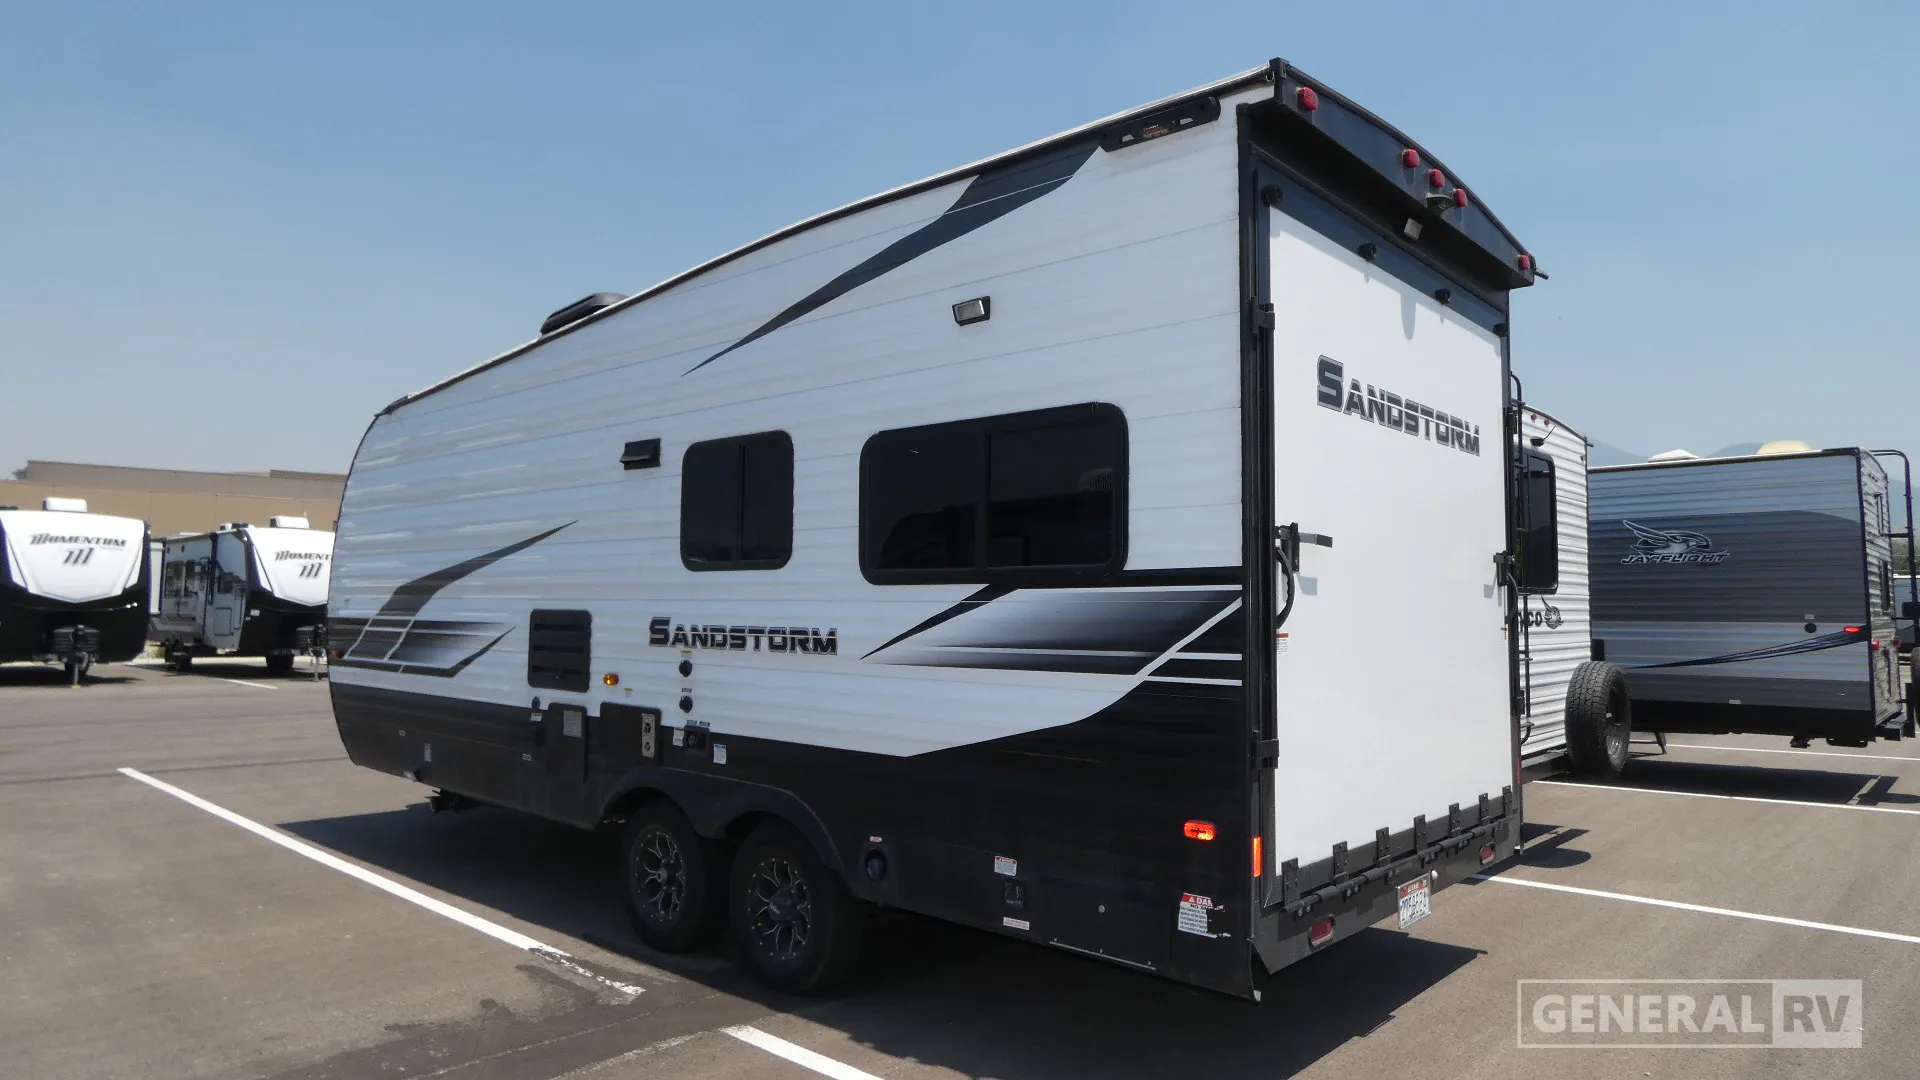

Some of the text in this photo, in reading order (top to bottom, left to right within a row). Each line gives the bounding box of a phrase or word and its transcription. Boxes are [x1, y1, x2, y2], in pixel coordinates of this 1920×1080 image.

[1316, 354, 1480, 456] SANDSTORM
[29, 533, 128, 547] MOMENTUM
[274, 550, 332, 561] MOMENT
[648, 616, 839, 655] SANDSTORM
